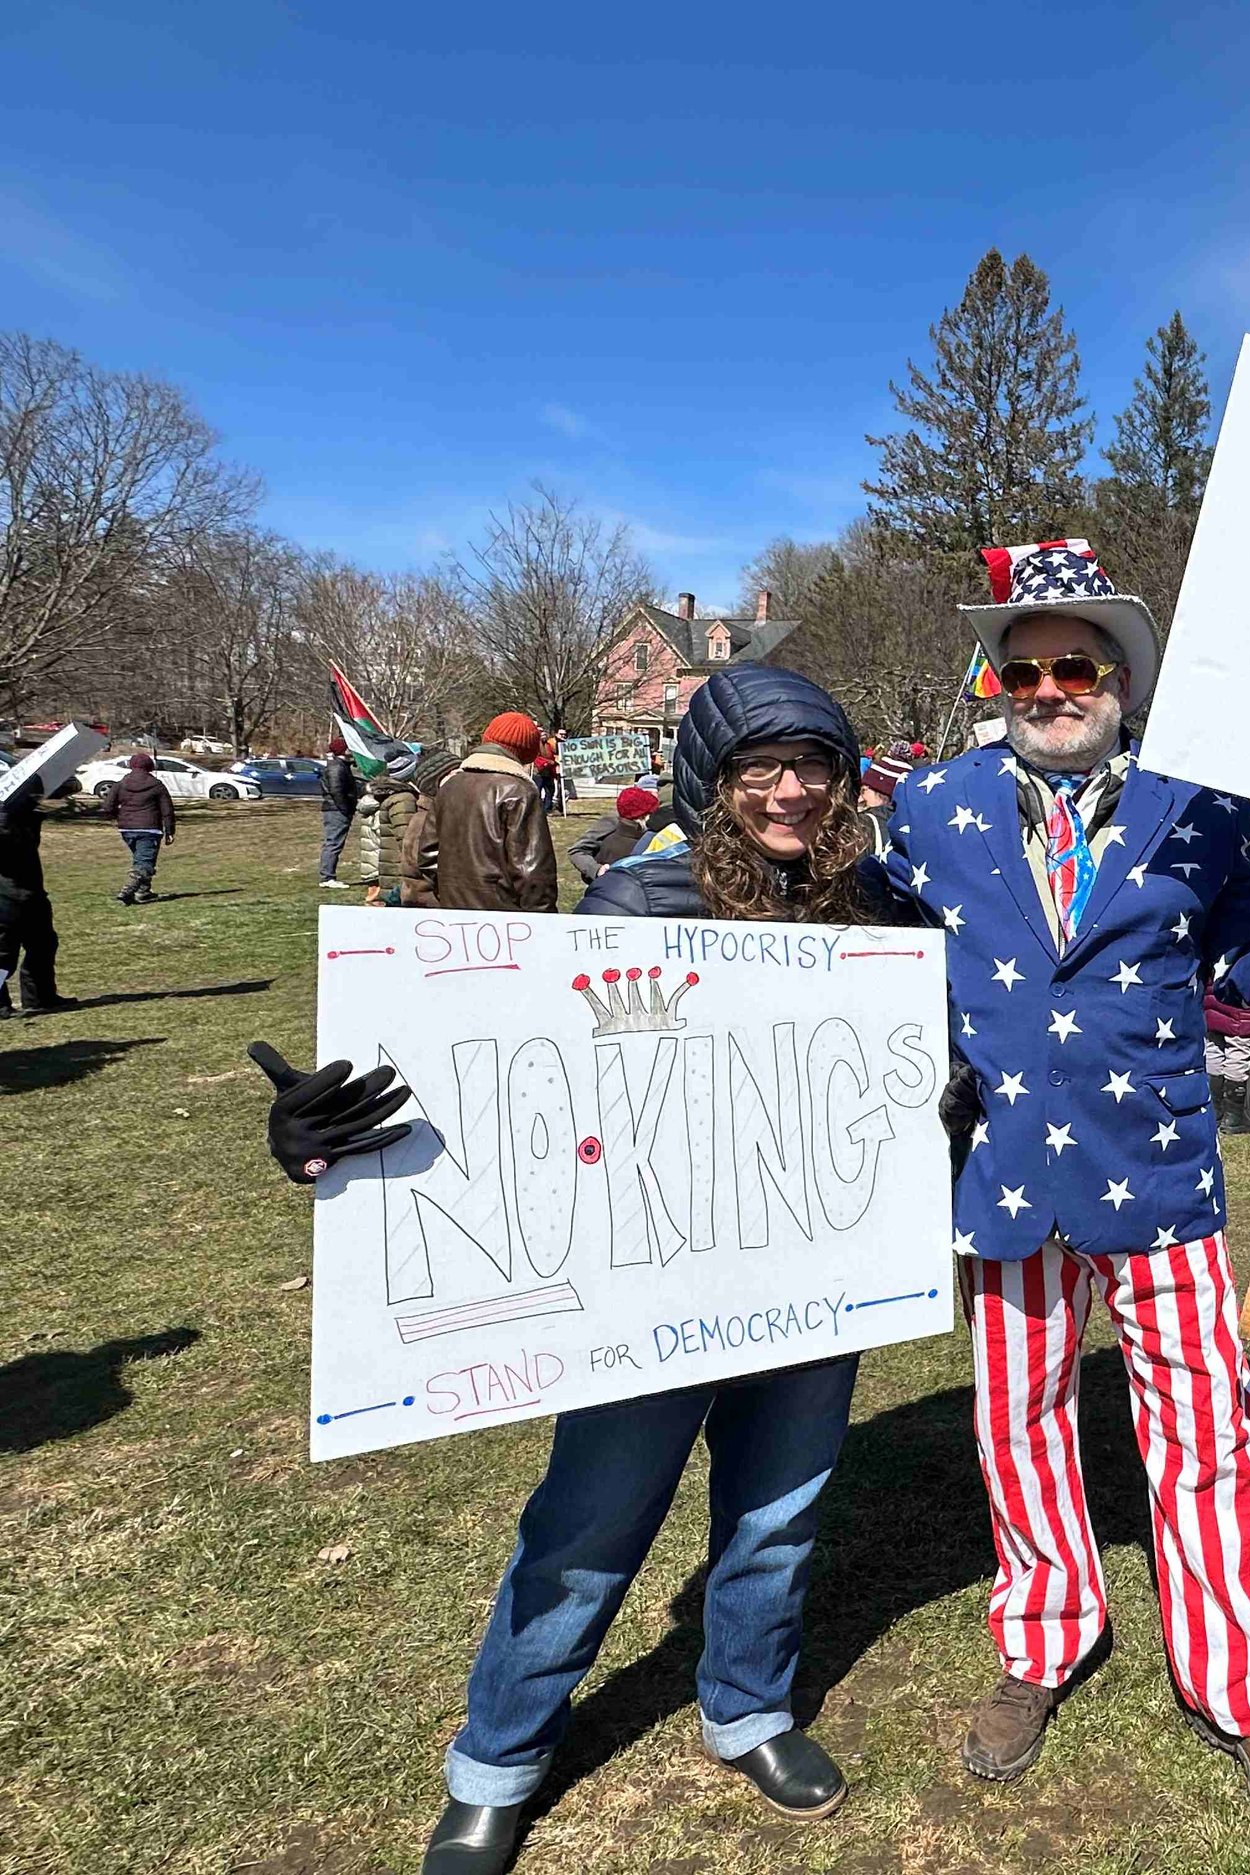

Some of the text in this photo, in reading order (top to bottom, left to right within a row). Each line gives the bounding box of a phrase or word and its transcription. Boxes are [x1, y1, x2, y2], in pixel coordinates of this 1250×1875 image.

[563, 742, 577, 752] NO
[605, 738, 617, 749] IS
[563, 752, 604, 767] ENOUGH
[608, 749, 629, 761] FOR
[414, 918, 842, 973] STOP THE HYPOCRISY
[379, 1037, 578, 1305] NO
[425, 1291, 848, 1416] STAND FOR DEMOCRACY
